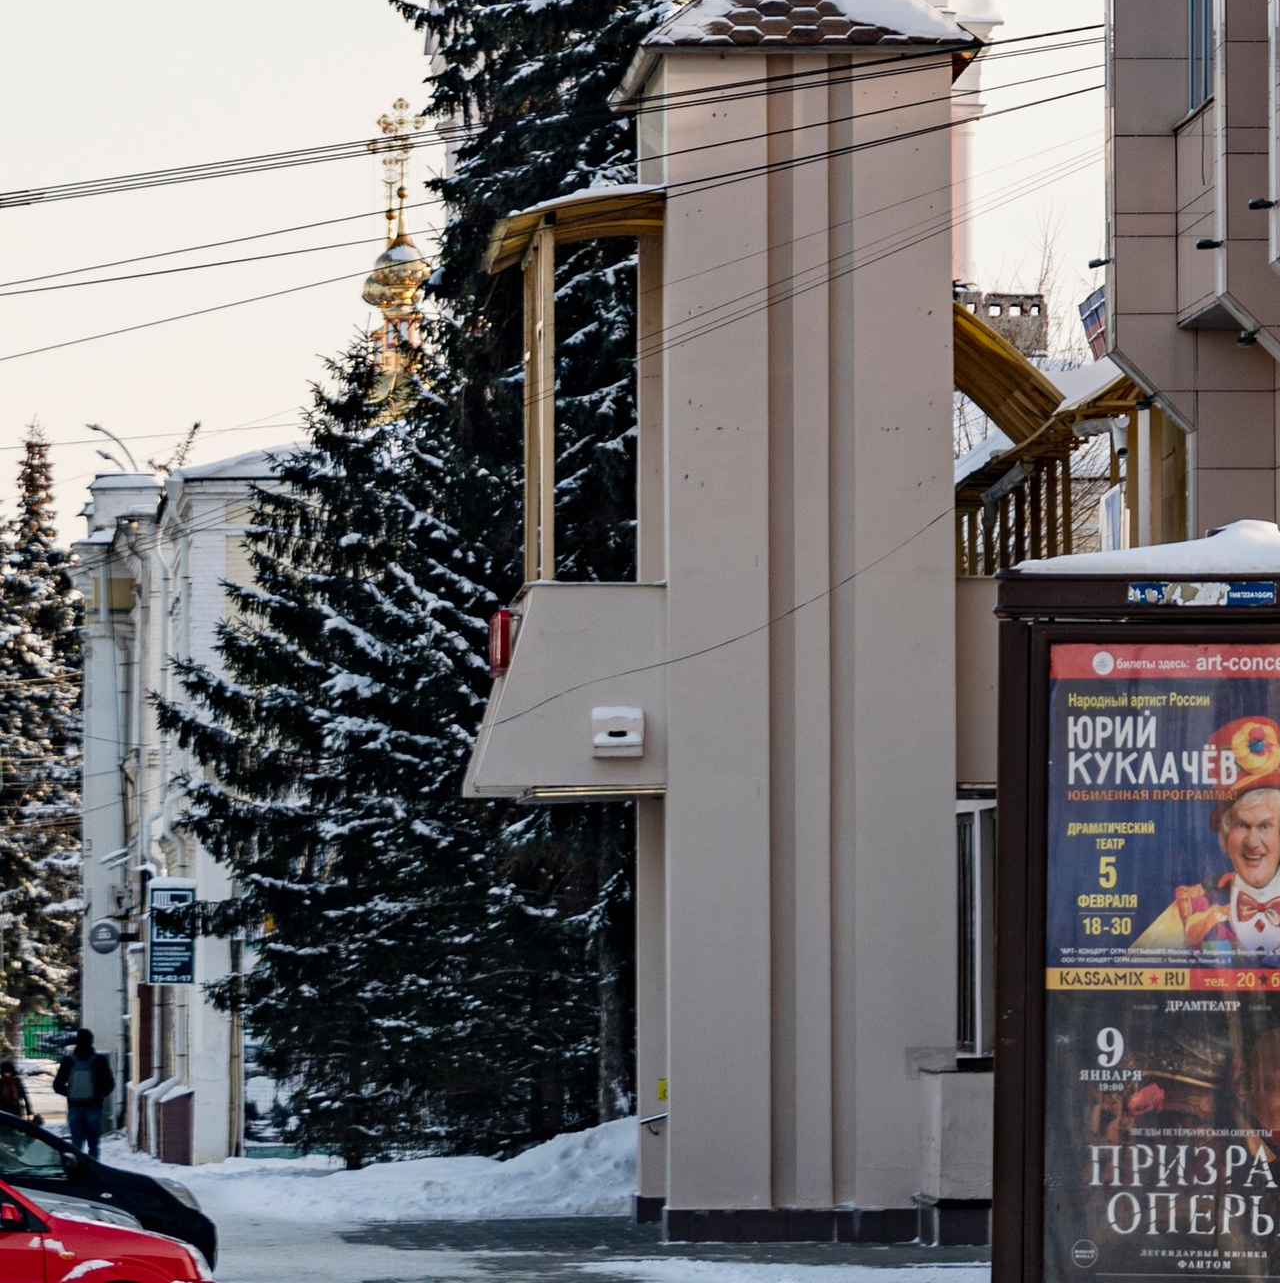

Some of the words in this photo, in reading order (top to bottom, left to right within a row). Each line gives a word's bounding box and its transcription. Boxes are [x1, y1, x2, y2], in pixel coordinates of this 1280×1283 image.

[1117, 658, 1155, 669] билеты
[1158, 659, 1190, 671] здесь:
[1068, 692, 1128, 709] Народный
[1131, 694, 1167, 710] артист
[1170, 692, 1210, 707] России
[1067, 709, 1157, 749] ЮРИЙ
[1068, 744, 1238, 785] КУКЛАЧЁВ
[1153, 789, 1238, 801] ПРОГРАММА!
[1067, 820, 1155, 836] ДРАМАТИЧЕСКИЙ
[1096, 838, 1125, 850] ТЕАТР
[1098, 856, 1117, 889] 5
[1077, 894, 1138, 908] ФЕВРАЛЯ
[1060, 971, 1144, 986] KASSAMIX
[1164, 971, 1185, 986] RU
[1203, 978, 1229, 987] тел.
[1236, 972, 1256, 988] 20
[1165, 1000, 1241, 1013] ДРАМТЕАТР
[1097, 1027, 1125, 1067] 9
[1079, 1069, 1142, 1081] ЯНВАРЯ
[1099, 1082, 1124, 1091] 19:00
[1129, 1128, 1161, 1137] ЗВЕЗДЫ
[1162, 1128, 1230, 1137] ПЕТЕРБУРГСКОЙ
[1230, 1128, 1273, 1137] ОПЕРЕТТЫ
[1141, 1248, 1219, 1258] ЛЕГЕНДАРНЫЙ
[1224, 1249, 1268, 1259] МЮЗИКЛ
[1177, 1260, 1232, 1270] ФАНТОМ
